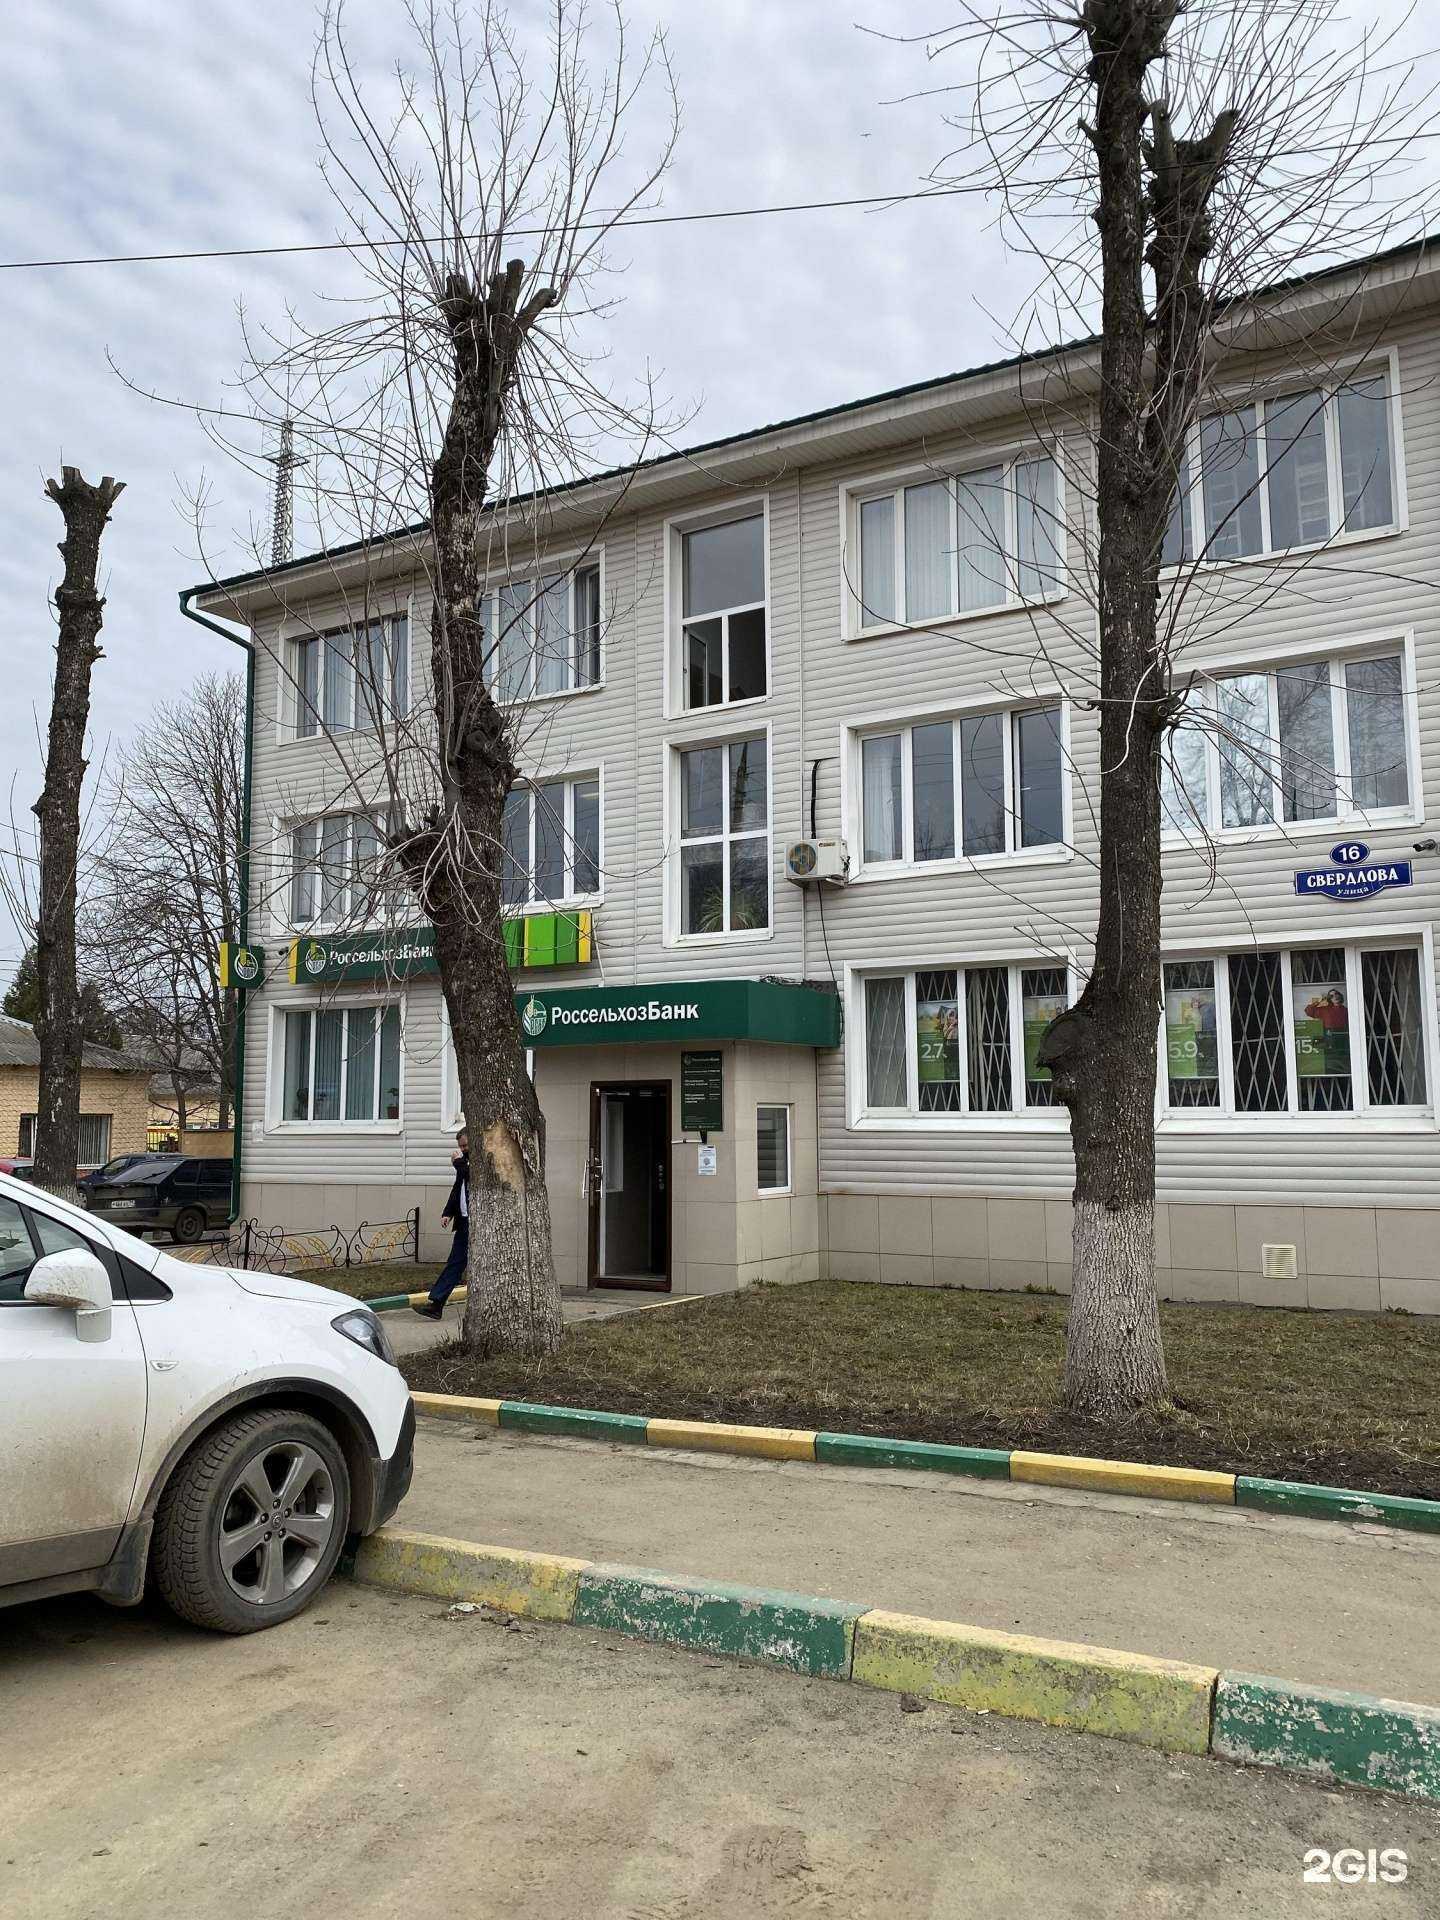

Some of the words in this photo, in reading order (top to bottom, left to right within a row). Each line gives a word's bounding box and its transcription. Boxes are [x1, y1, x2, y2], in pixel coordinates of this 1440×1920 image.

[1339, 845, 1360, 861] 16
[1307, 867, 1399, 888] СВЕРДЛОВА
[1336, 885, 1370, 896] улица
[330, 944, 434, 966] РоссельхозБан
[551, 1000, 699, 1025] РоссельхозБанк
